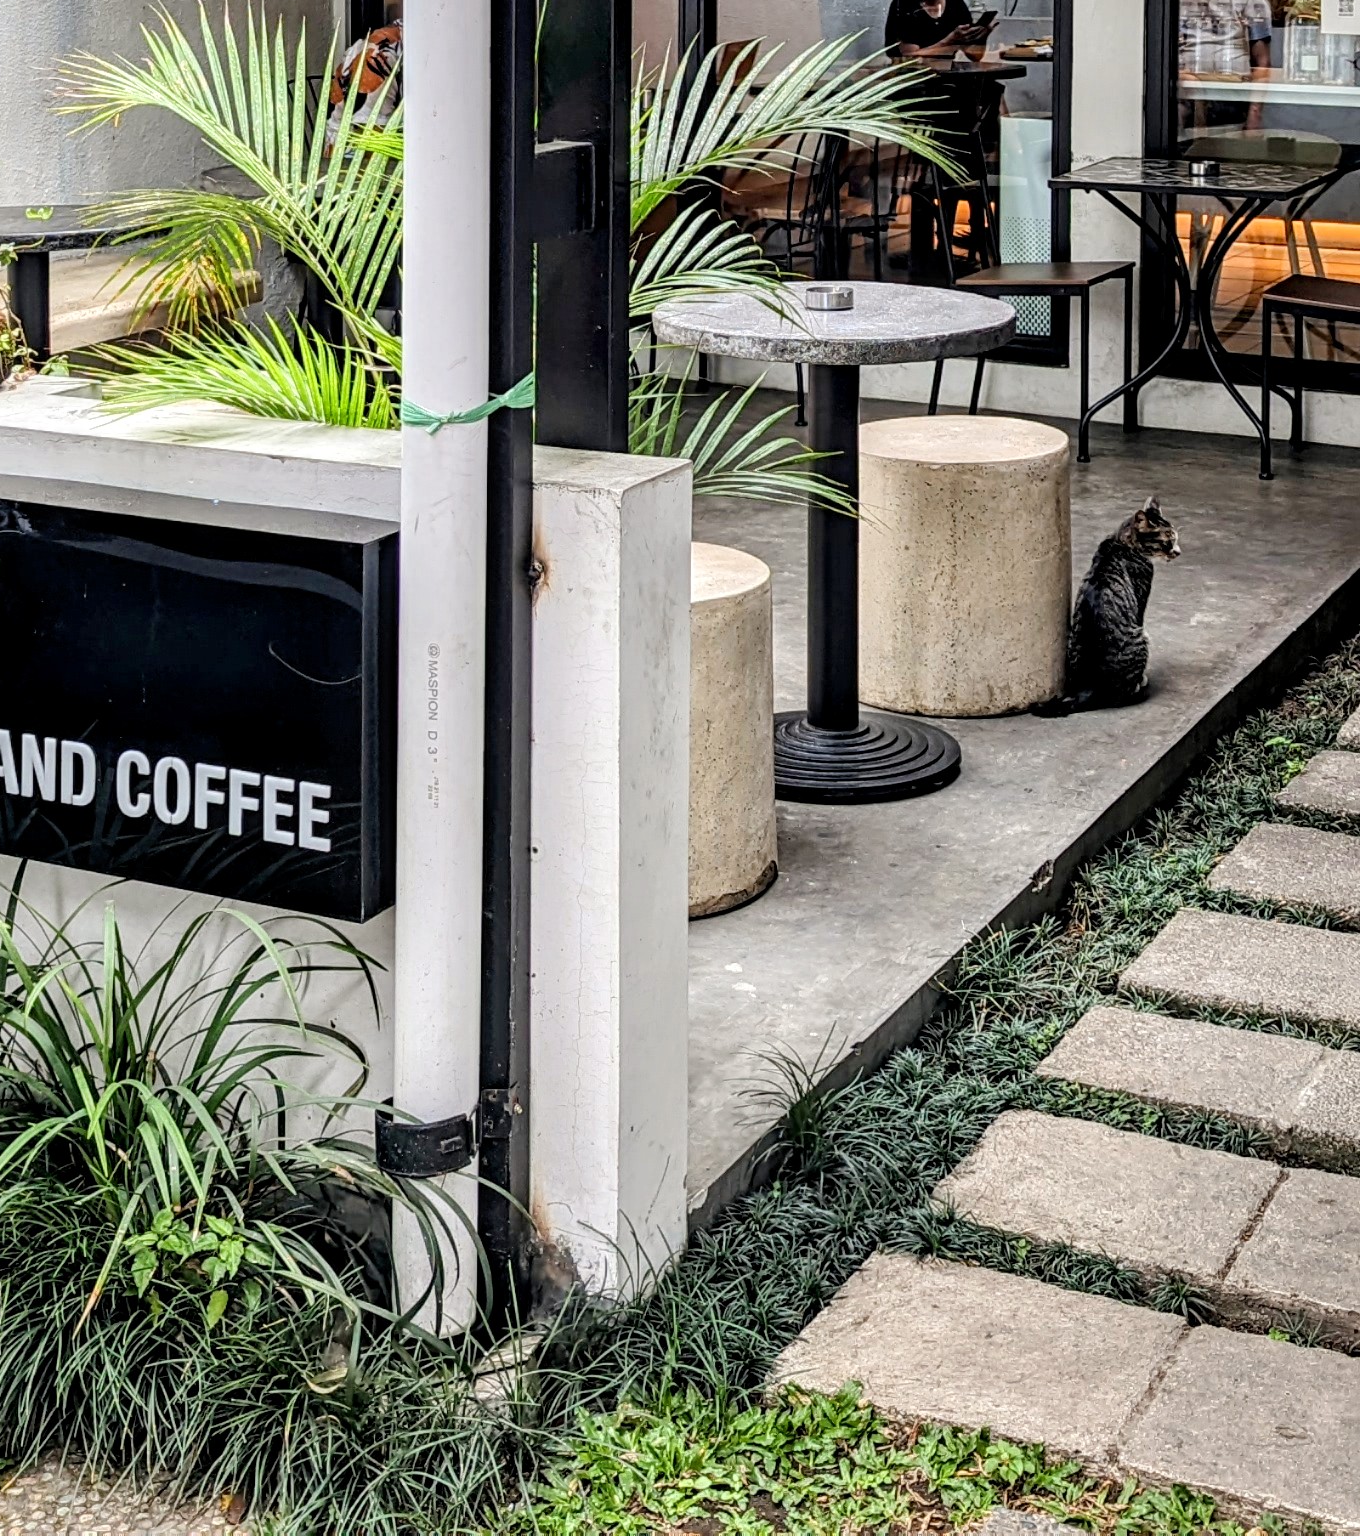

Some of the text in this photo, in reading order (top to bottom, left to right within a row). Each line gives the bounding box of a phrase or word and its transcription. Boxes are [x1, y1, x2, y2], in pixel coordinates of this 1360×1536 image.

[428, 660, 438, 721] MASPION
[428, 730, 438, 740] D
[116, 749, 332, 853] COFFEE
